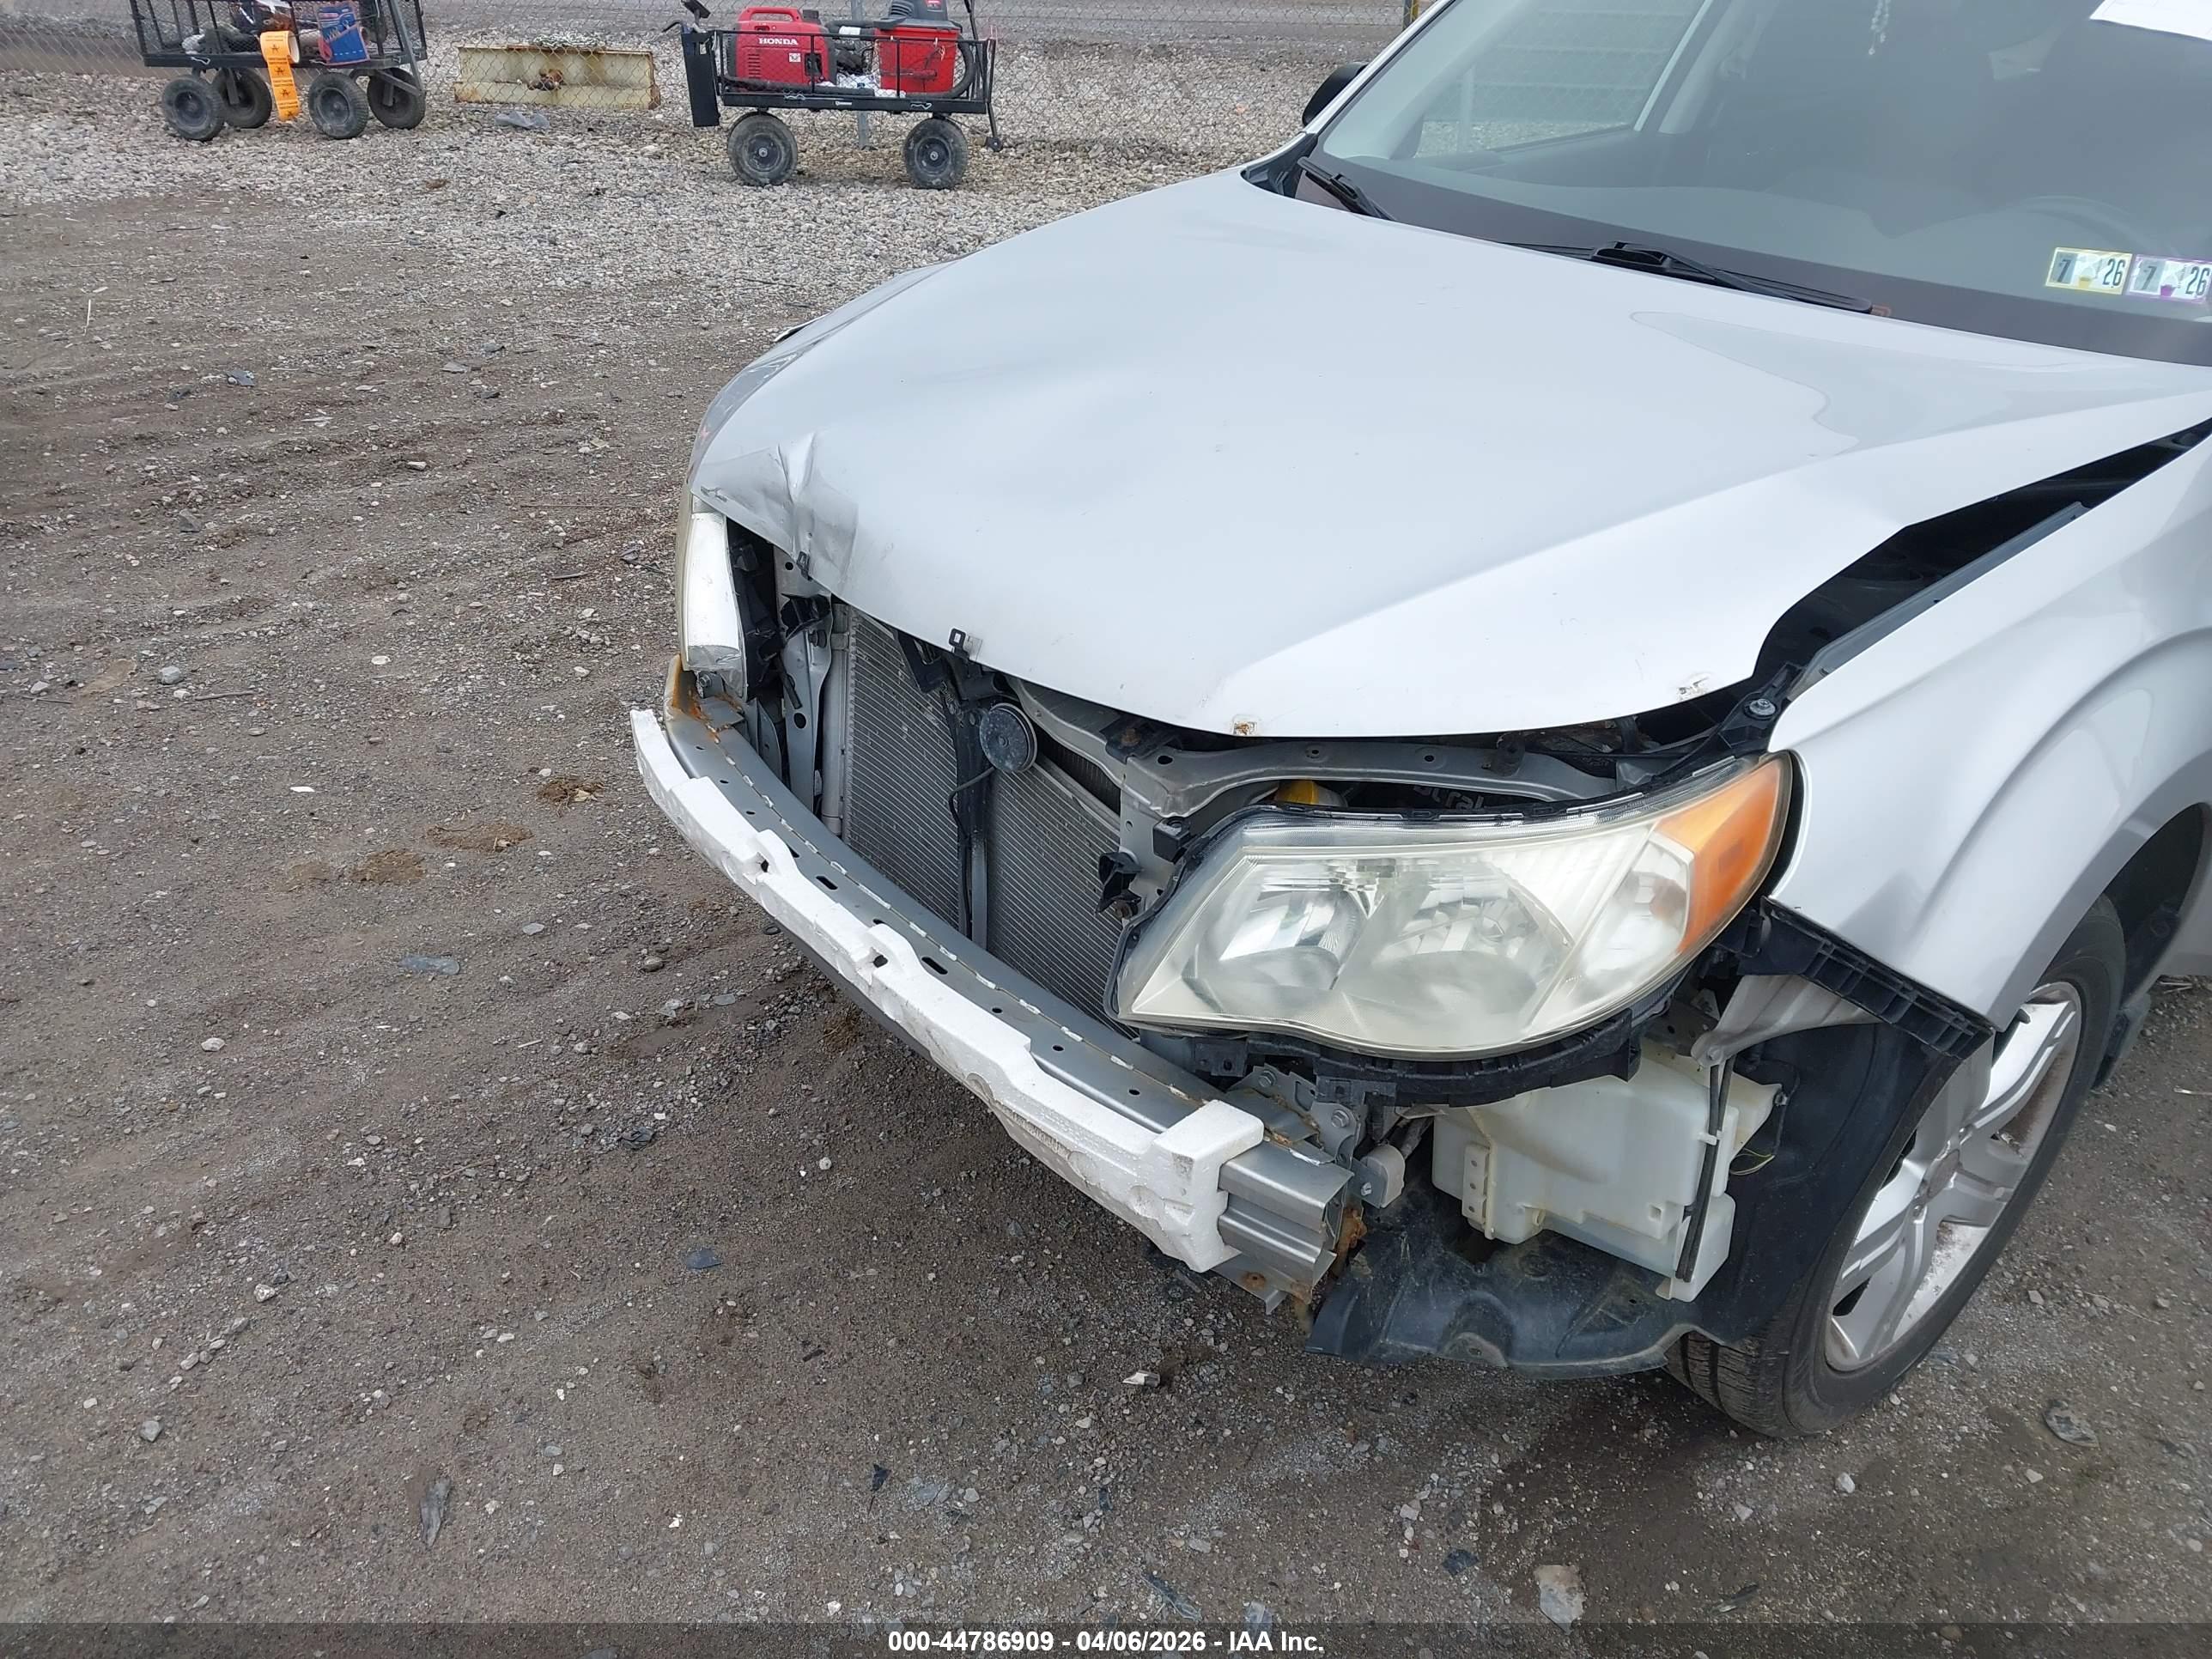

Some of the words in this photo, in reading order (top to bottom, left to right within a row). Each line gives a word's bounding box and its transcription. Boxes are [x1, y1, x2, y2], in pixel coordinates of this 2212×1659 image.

[2057, 258, 2071, 283] 7
[2102, 258, 2125, 286] 26
[2142, 265, 2157, 290] 7
[2185, 265, 2212, 295] 26
